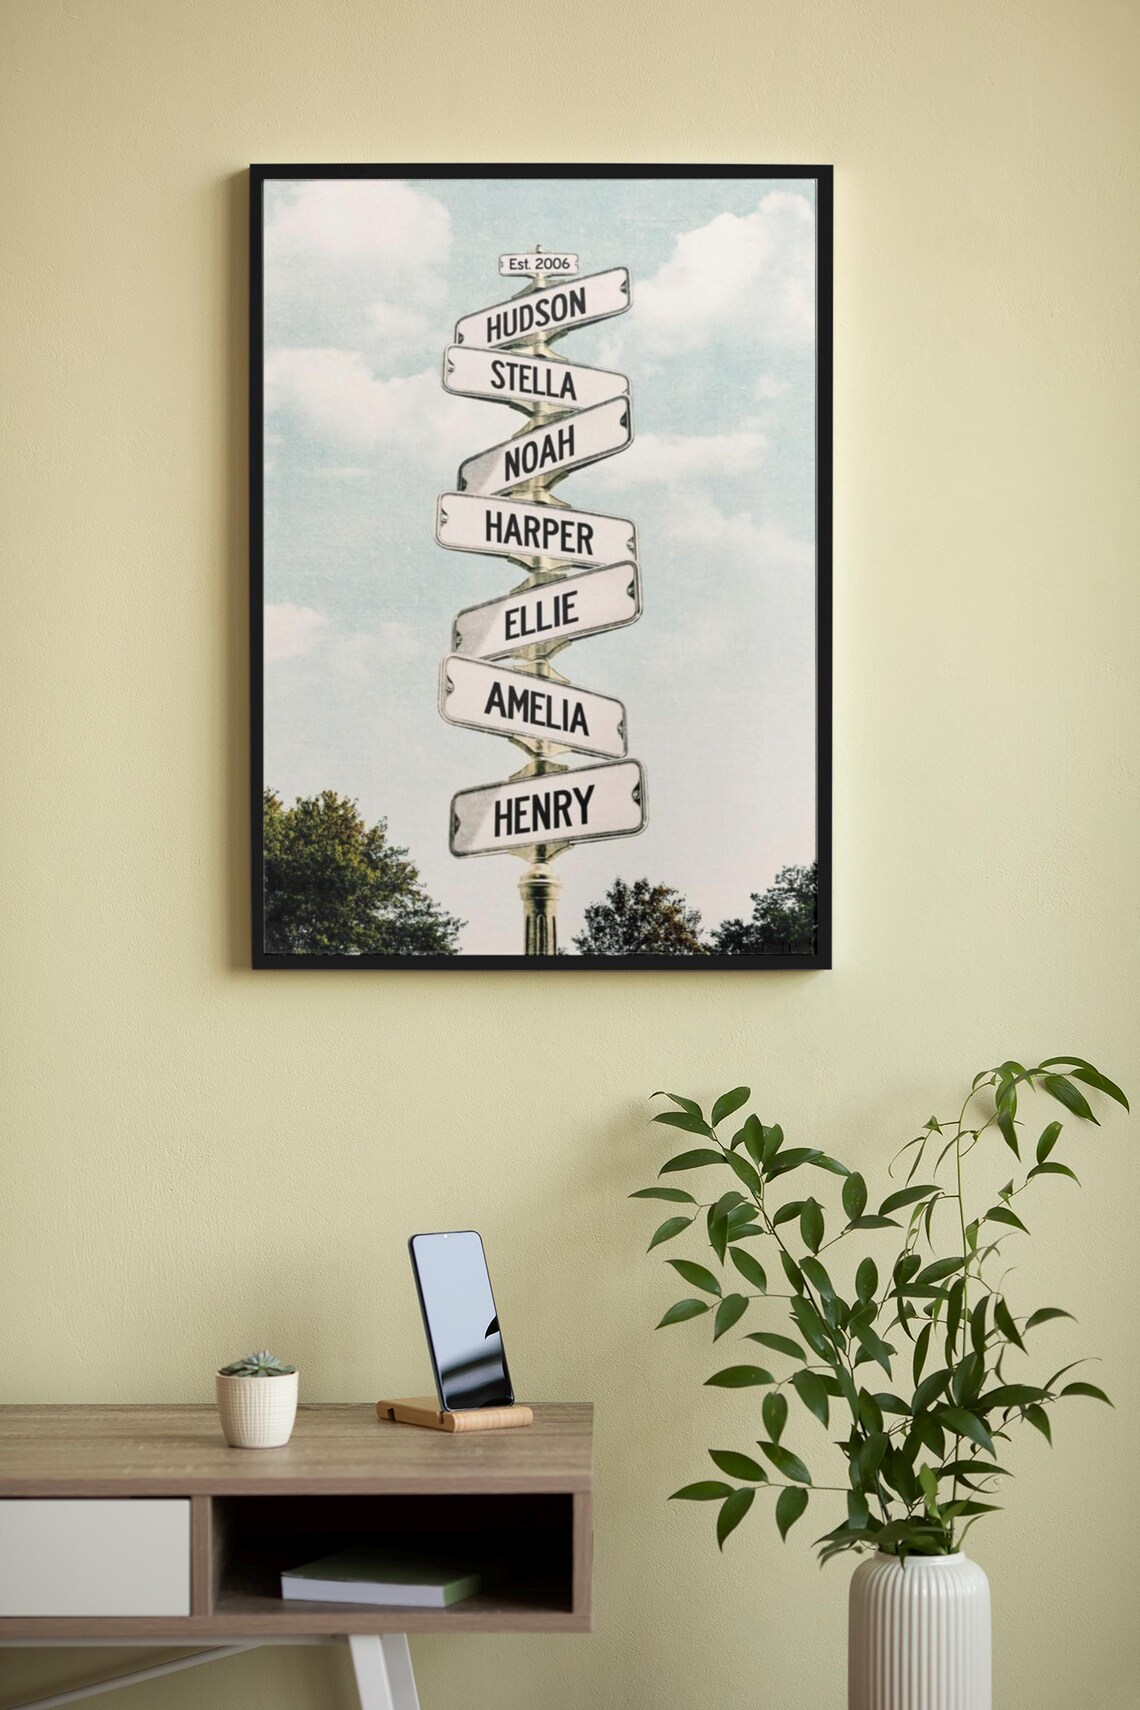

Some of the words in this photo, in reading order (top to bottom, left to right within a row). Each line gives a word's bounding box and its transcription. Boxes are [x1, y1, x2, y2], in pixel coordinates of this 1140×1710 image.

[509, 258, 531, 270] Est.
[535, 258, 570, 270] 2006
[487, 287, 586, 343] HUDSON
[490, 360, 577, 401] STELLA
[505, 424, 575, 482] NOAH
[486, 509, 594, 556] HARPER
[505, 590, 579, 641] ELLIE
[484, 681, 590, 737] AMELIA
[494, 784, 595, 838] HENRY
